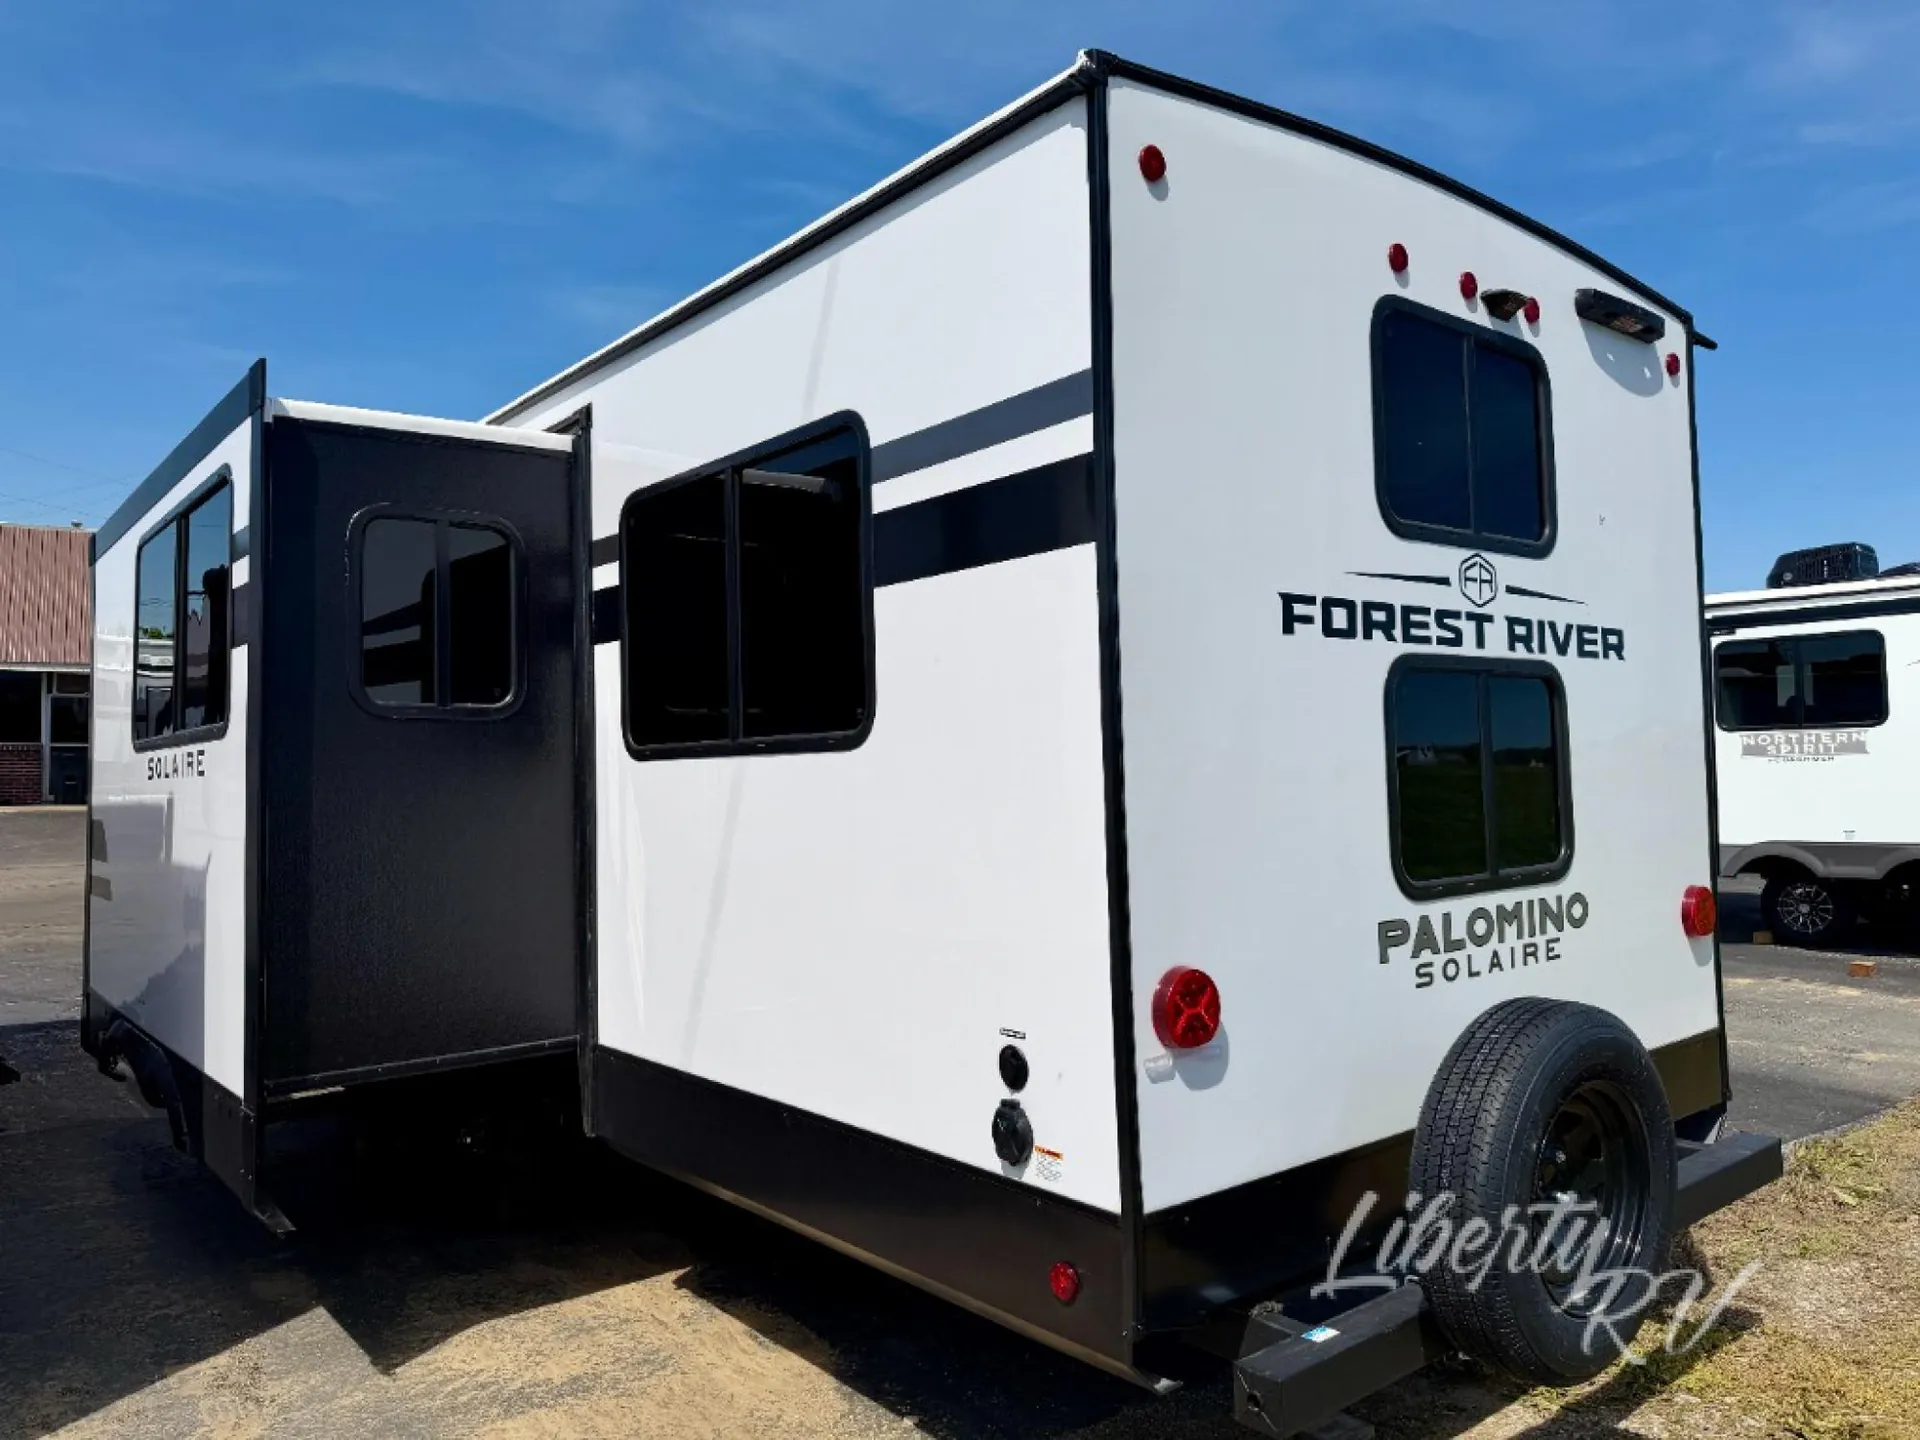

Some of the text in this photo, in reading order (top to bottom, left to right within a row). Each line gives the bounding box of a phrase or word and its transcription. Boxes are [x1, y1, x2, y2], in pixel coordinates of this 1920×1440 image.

[1278, 592, 1625, 661] FOREST RIVER
[1743, 732, 1866, 745] NORTHERN
[1767, 743, 1836, 755] SPIRIT
[147, 750, 205, 780] SOLAIRE
[1378, 892, 1589, 964] PALOMINO
[1415, 938, 1561, 988] SOLAIRE
